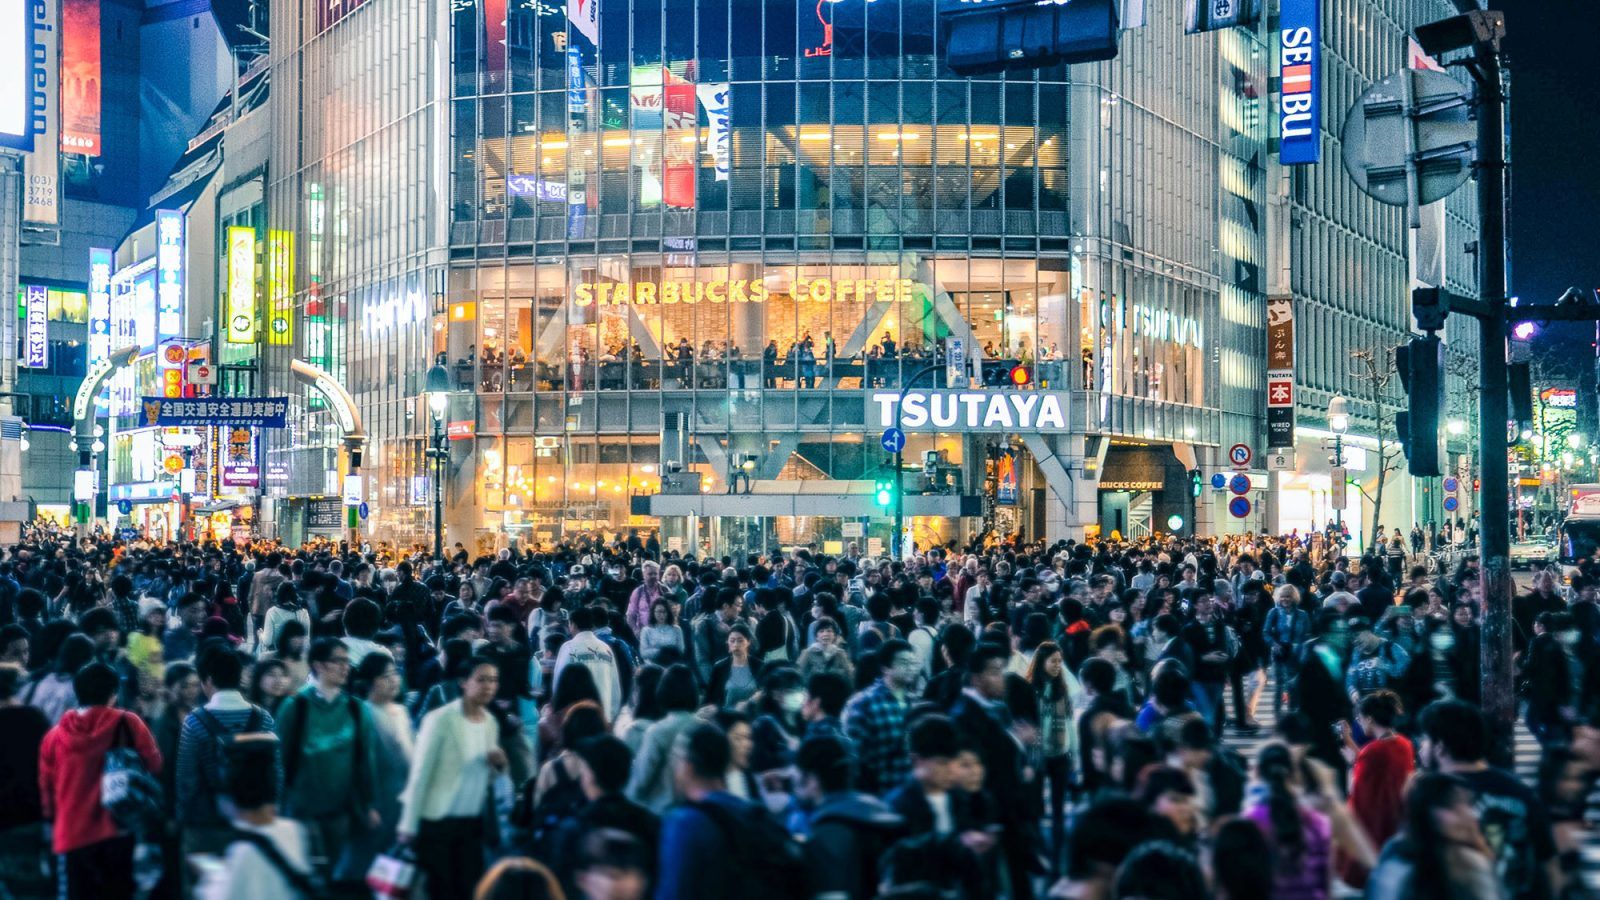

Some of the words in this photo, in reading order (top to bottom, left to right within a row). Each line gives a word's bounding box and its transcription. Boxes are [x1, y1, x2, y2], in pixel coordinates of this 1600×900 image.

[1281, 27, 1312, 140] SEIBU
[30, 175, 52, 186] (03)
[29, 187, 53, 196] 3719
[28, 196, 53, 207] 2468
[575, 279, 769, 307] STARBUCKS
[789, 278, 913, 303] COFFEE
[1271, 384, 1289, 402] 本
[161, 401, 285, 418] 全国交通安全運動実施中
[873, 393, 1066, 428] TSUTAYA
[1130, 481, 1163, 489] COFFEE
